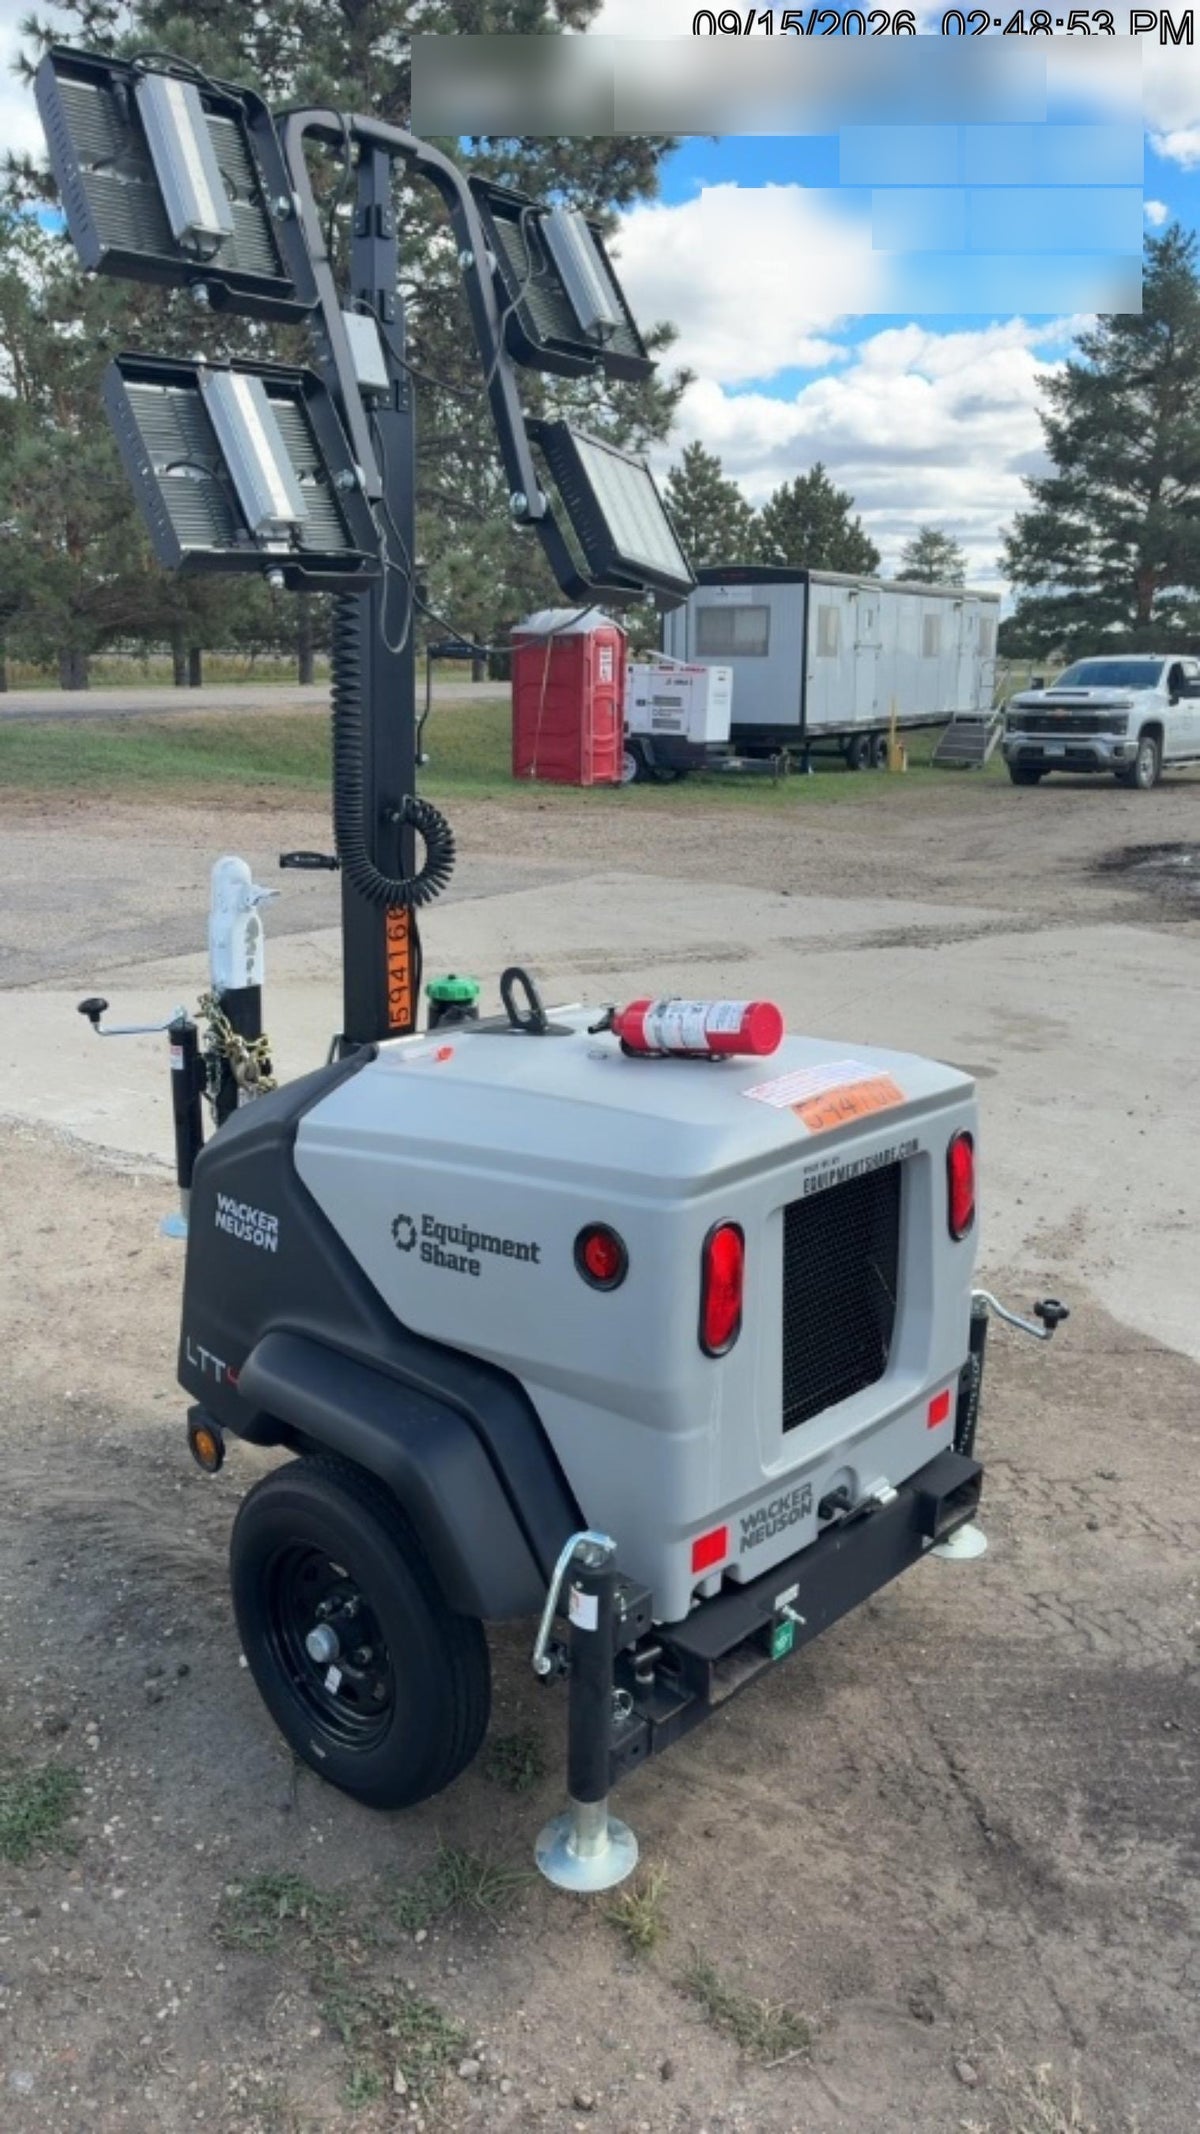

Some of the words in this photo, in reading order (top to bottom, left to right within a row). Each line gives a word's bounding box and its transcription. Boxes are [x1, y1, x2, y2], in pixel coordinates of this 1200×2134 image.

[215, 1210, 279, 1253] NEUSON
[217, 1192, 279, 1234] WACKER
[420, 1241, 481, 1277] Share
[421, 1213, 541, 1265] Equipment
[740, 1481, 812, 1534] WACKER
[740, 1499, 812, 1554] NEUSON
